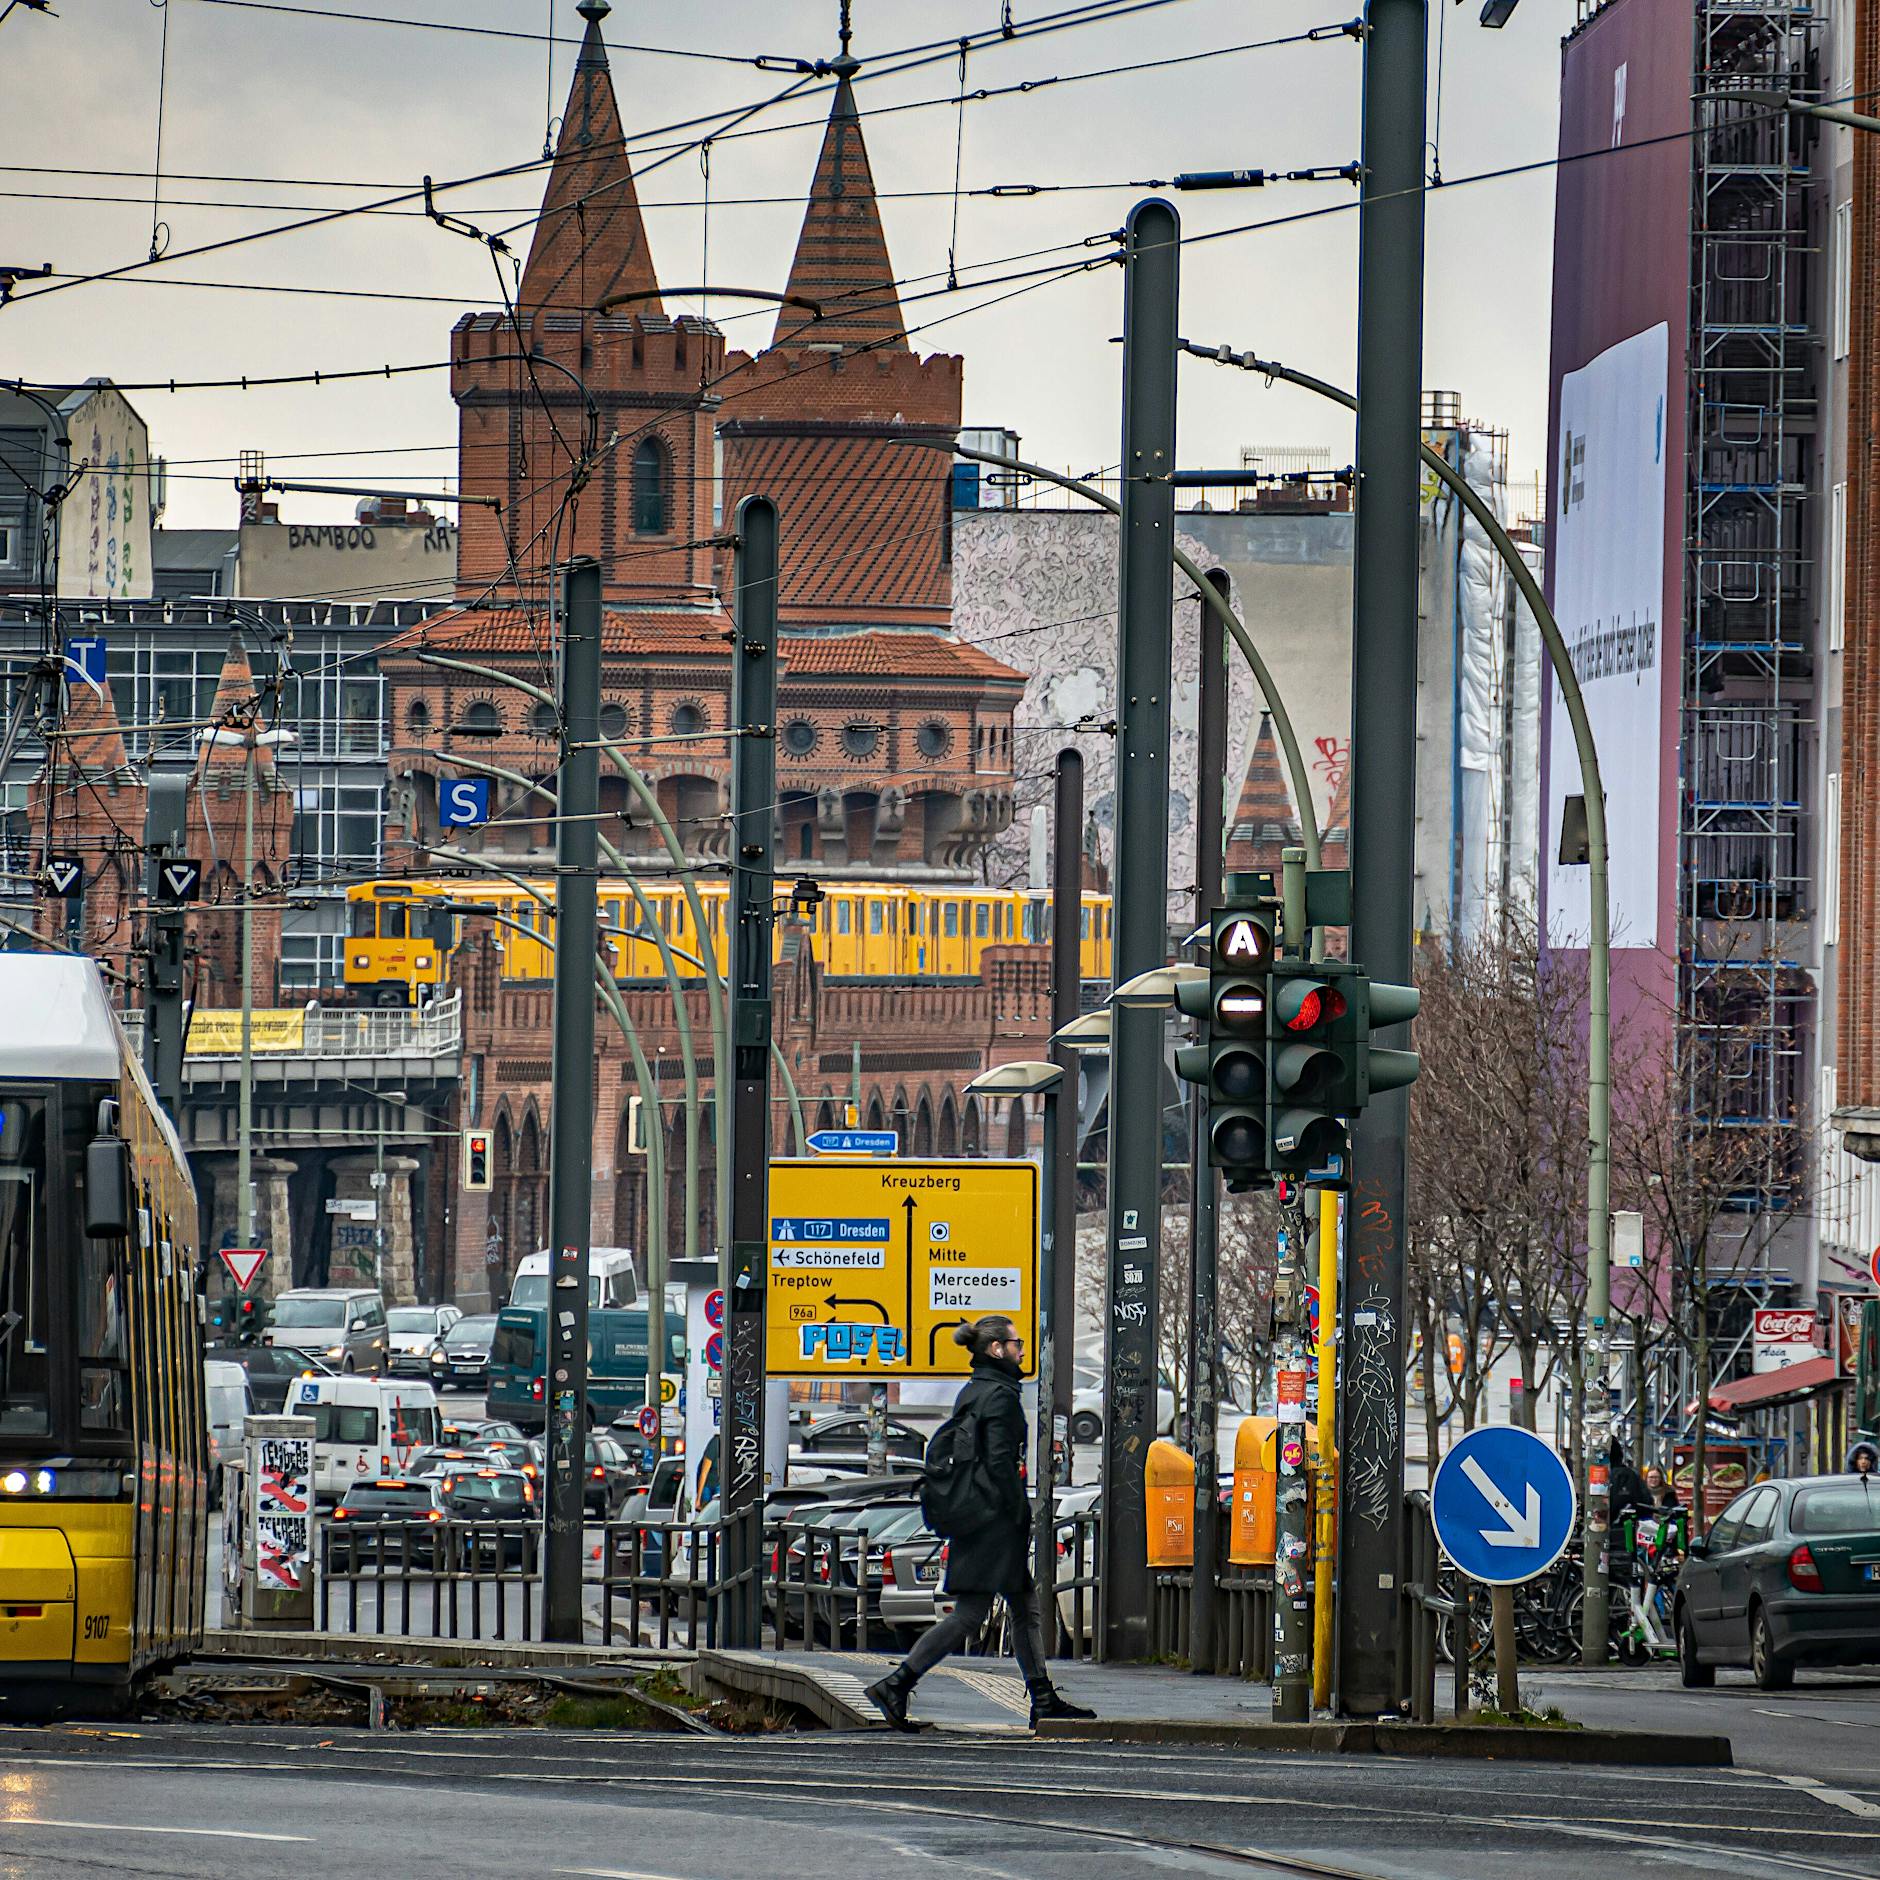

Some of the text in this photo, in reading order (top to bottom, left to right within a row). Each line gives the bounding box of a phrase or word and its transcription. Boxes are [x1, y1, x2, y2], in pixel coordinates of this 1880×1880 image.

[288, 526, 377, 550] BAMBOO
[70, 642, 97, 678] T
[448, 784, 479, 826] S
[1226, 920, 1258, 956] A
[854, 1137, 890, 1147] Dresden
[881, 1174, 961, 1192] Kreuzberg
[809, 1223, 886, 1238] 117 Dresden
[795, 1251, 880, 1266] Schönefeld
[929, 1248, 967, 1262] Mitte
[772, 1274, 833, 1290] Treptow
[934, 1273, 1016, 1287] Mercedes-
[934, 1292, 972, 1306] Platz
[793, 1308, 813, 1319] 96a
[1759, 1344, 1787, 1357] Asia
[1167, 1519, 1184, 1532] BSR
[84, 1615, 110, 1640] 9107
